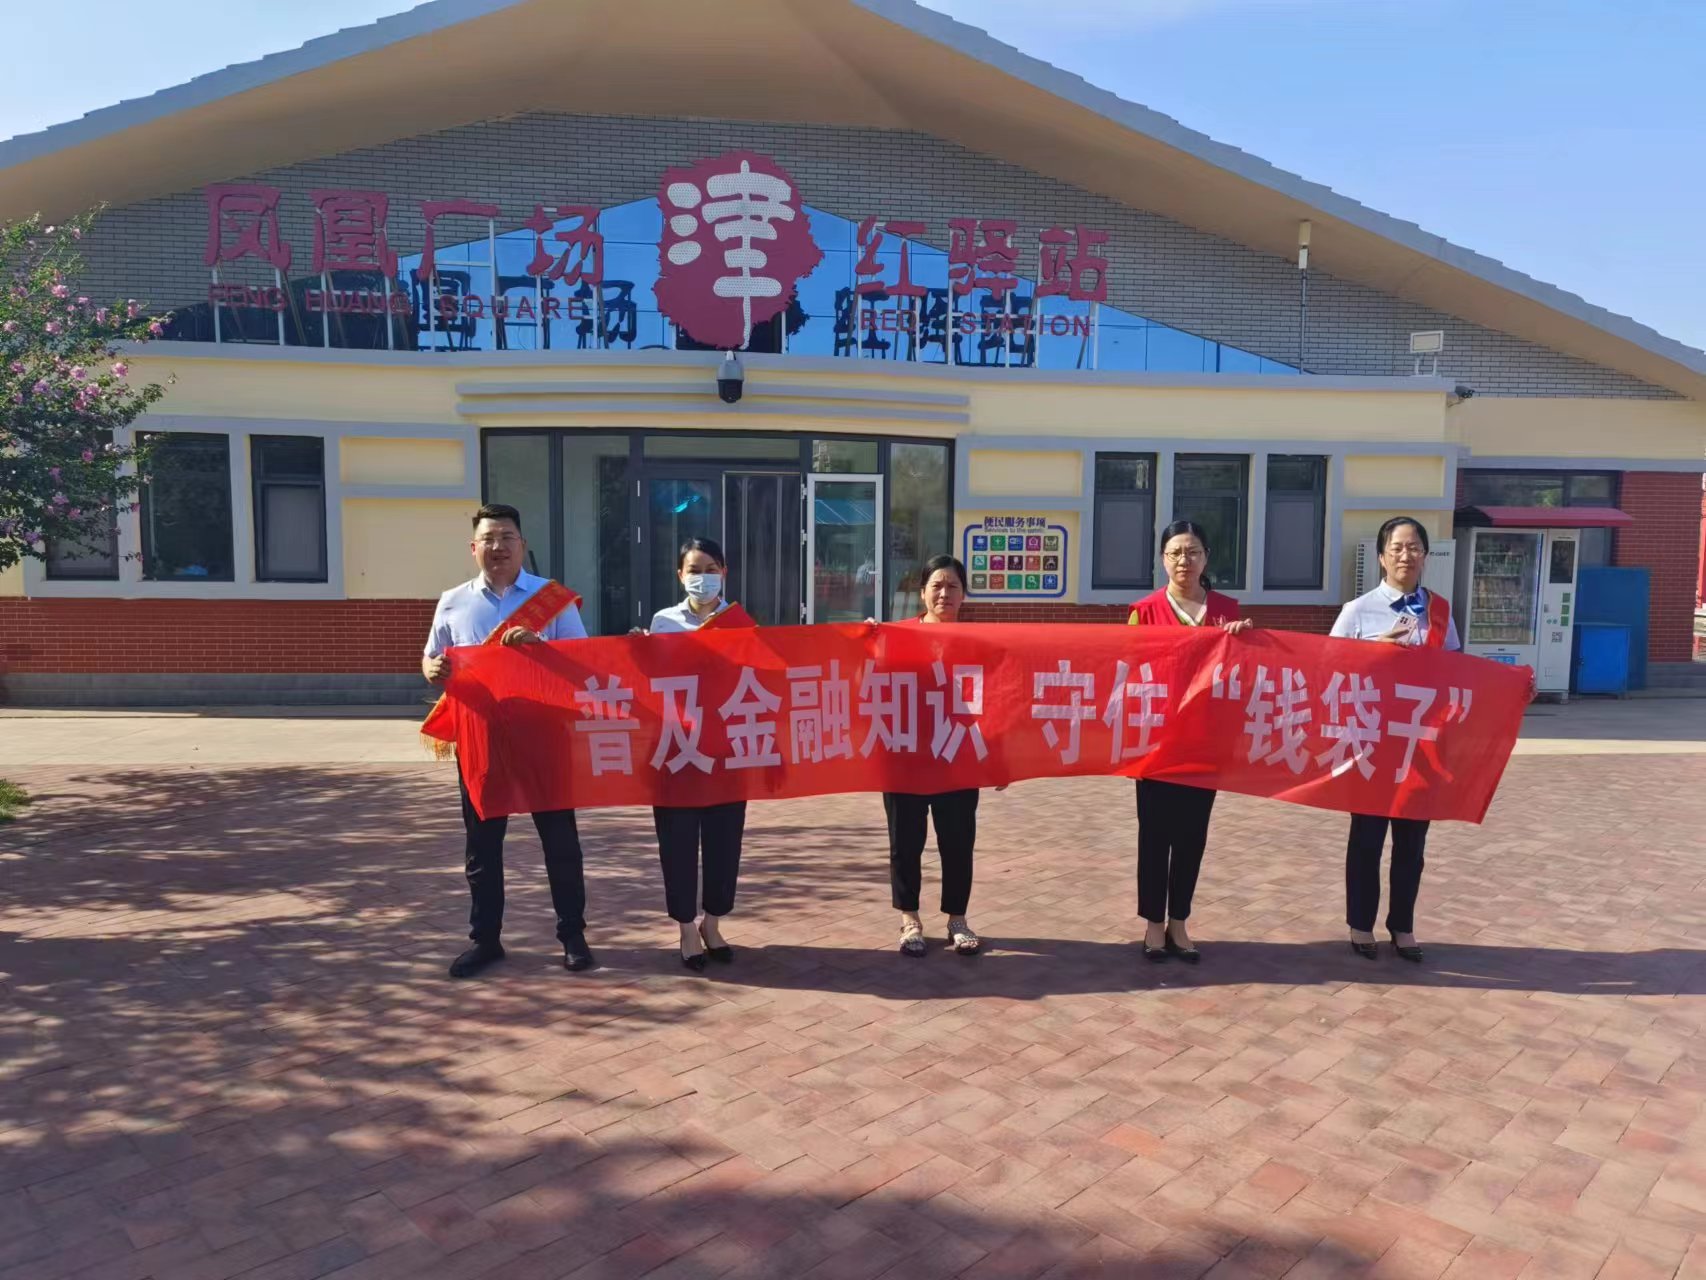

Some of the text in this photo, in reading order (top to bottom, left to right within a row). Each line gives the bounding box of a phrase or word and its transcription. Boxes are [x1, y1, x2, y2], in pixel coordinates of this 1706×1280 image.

[203, 160, 1110, 349] 凤凰广场 津 红驿站
[208, 284, 1092, 337] FENG HUANG SQUARE RED STATION
[574, 659, 1473, 783] 普及金融知识 守住 “钱袋子”
